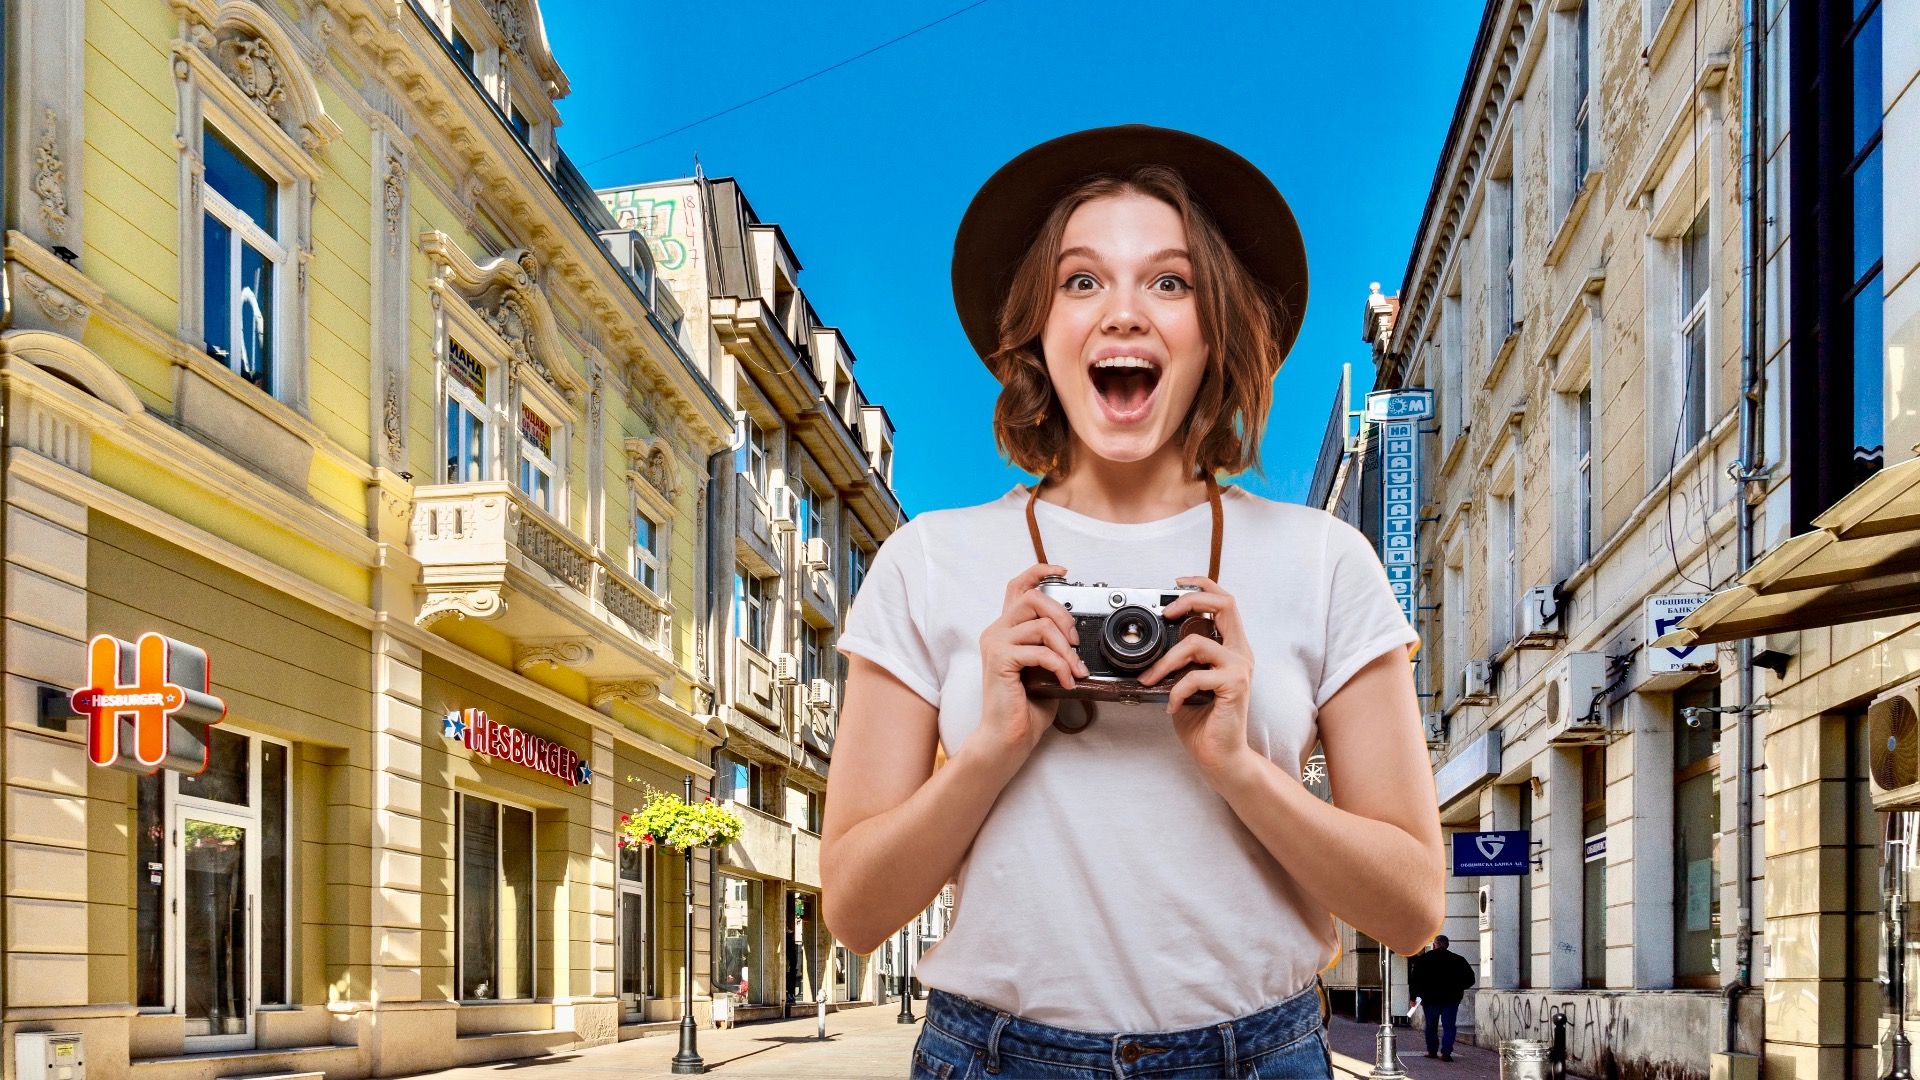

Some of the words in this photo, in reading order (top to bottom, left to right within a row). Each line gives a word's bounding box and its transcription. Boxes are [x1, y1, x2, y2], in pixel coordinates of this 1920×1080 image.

[1390, 426, 1408, 436] НА
[92, 693, 164, 707] HESBURGER
[464, 708, 579, 787] HESBURGER
